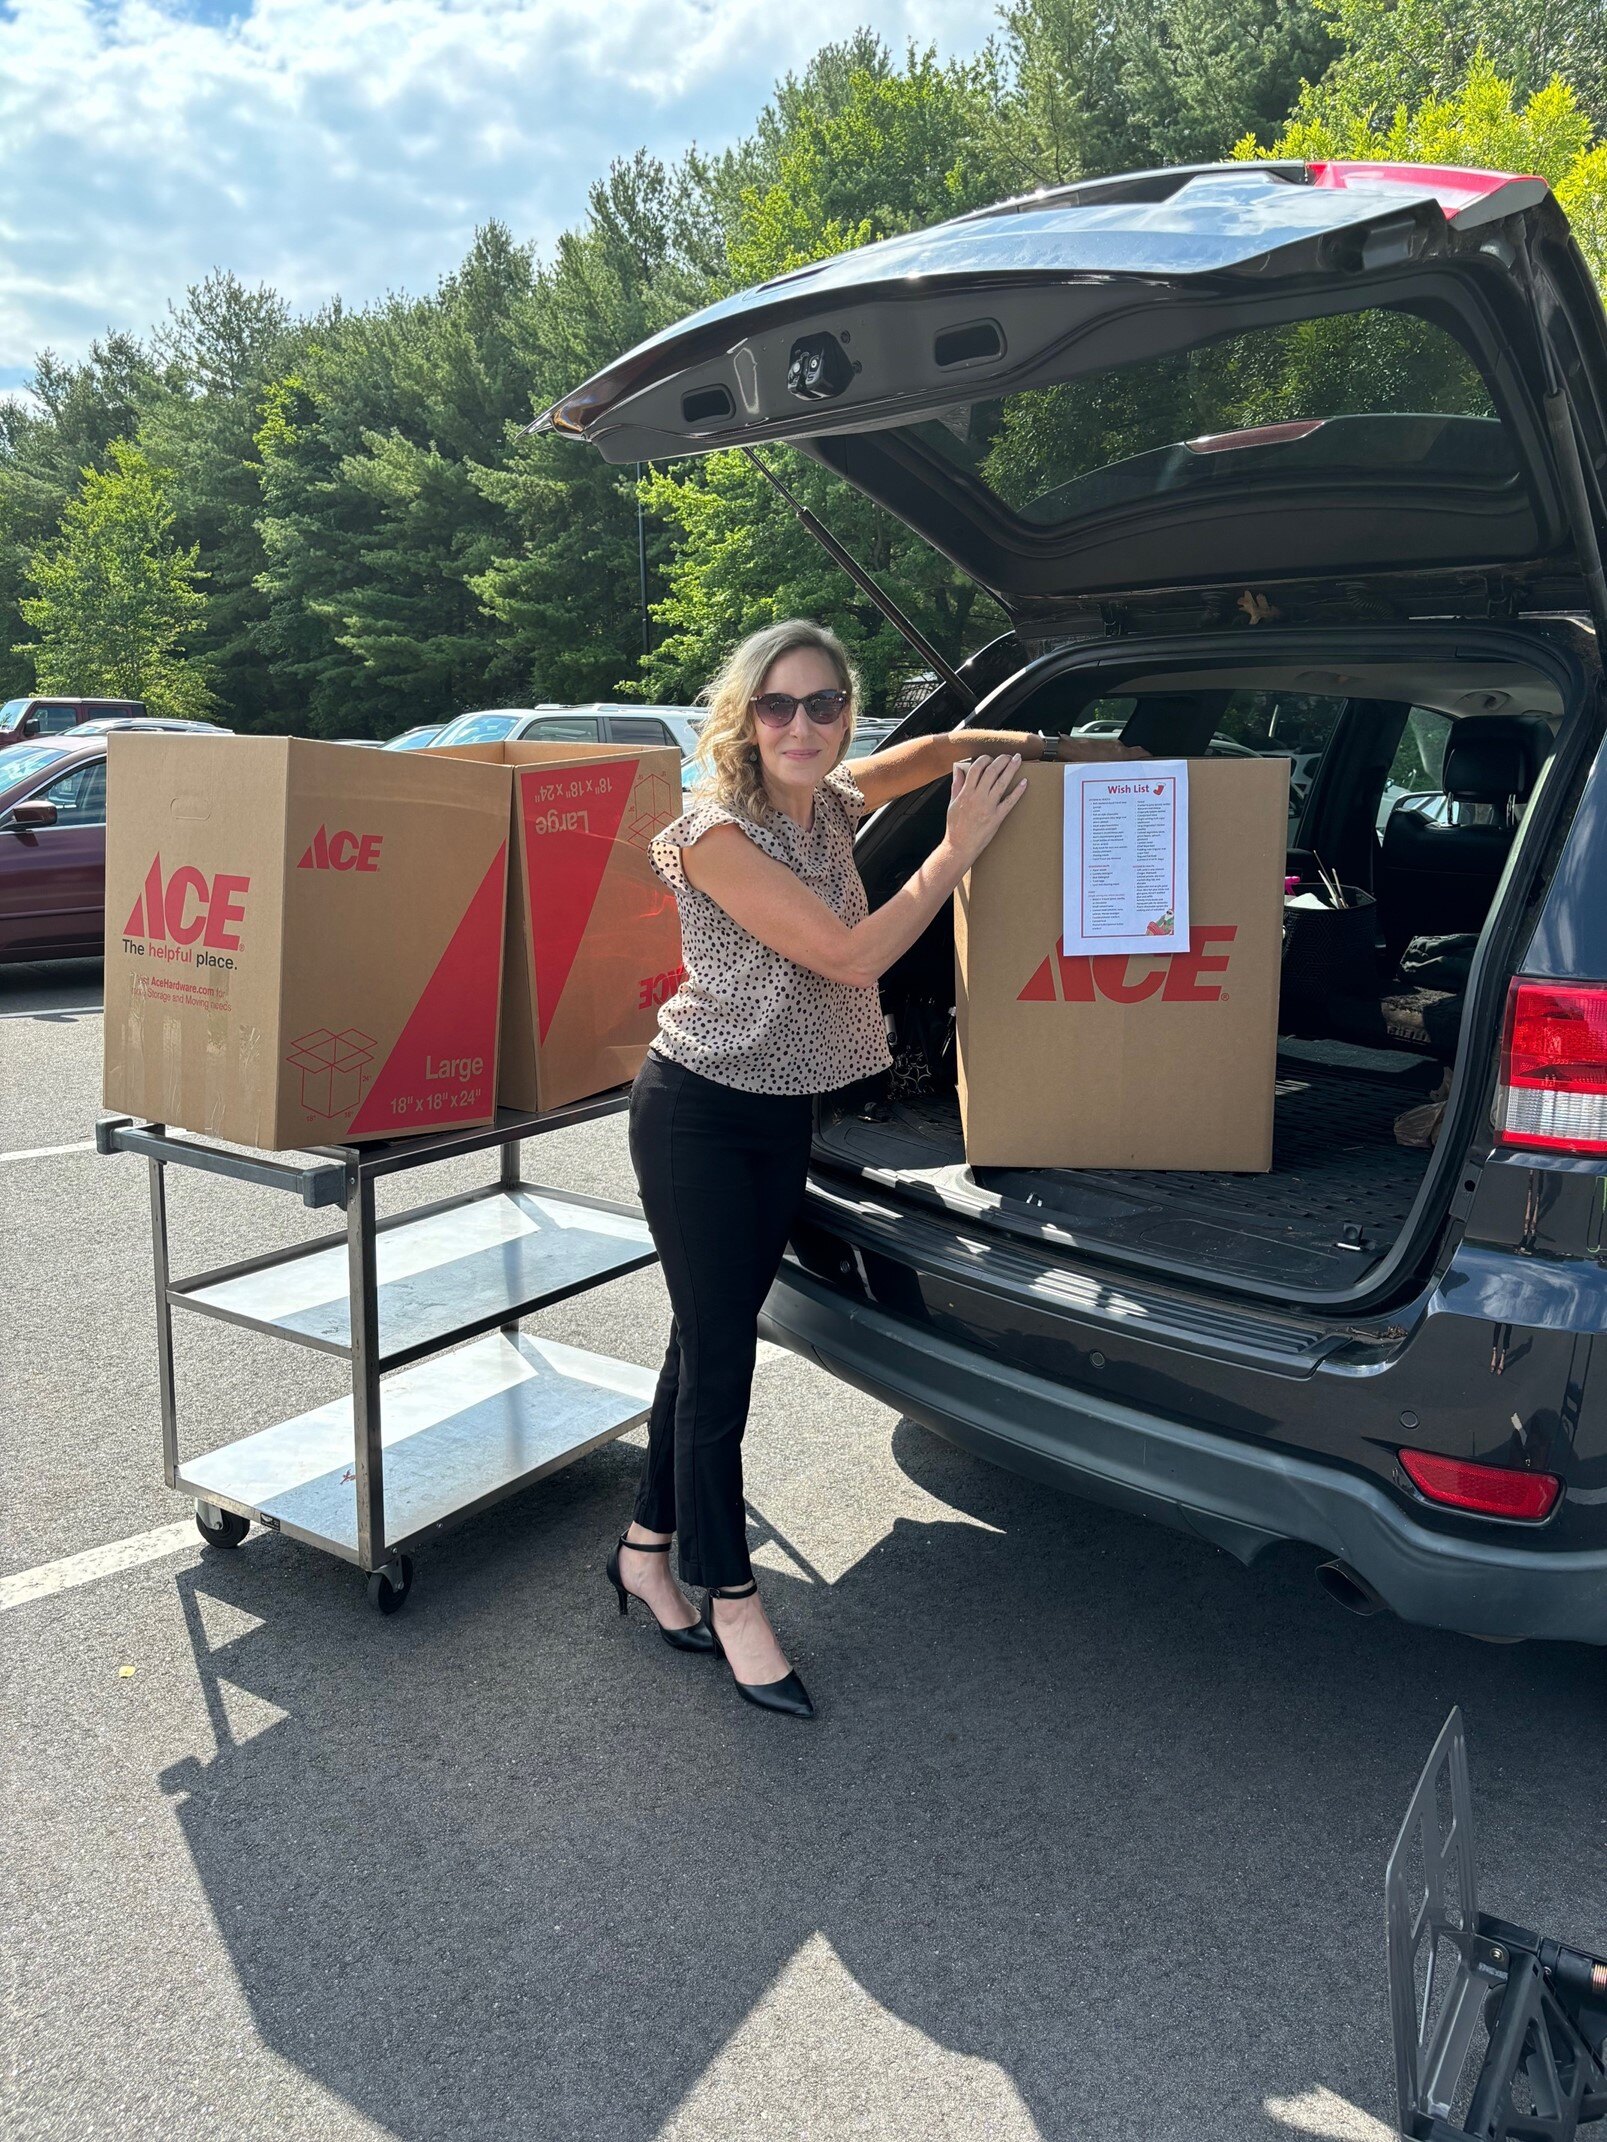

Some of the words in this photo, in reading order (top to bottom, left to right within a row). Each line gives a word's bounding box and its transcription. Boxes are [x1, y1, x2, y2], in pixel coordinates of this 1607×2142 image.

[535, 784, 556, 803] 24"
[556, 783, 563, 796] x
[566, 781, 585, 798] 18"
[586, 779, 593, 792] x
[595, 777, 613, 795] 18"
[1107, 785, 1131, 795] Wish
[1133, 784, 1150, 794] List
[535, 809, 589, 835] Large
[296, 823, 384, 872] ACE
[122, 850, 251, 952] ACE
[122, 938, 145, 956] The
[148, 942, 192, 963] helpful
[196, 951, 238, 971] place.
[151, 976, 215, 997] AceHardware.com
[215, 987, 226, 998] for
[147, 988, 171, 1003] Storage
[172, 993, 184, 1004] and
[185, 995, 209, 1011] Moving
[210, 1001, 232, 1013] needs
[425, 1055, 484, 1082] Large
[390, 1096, 414, 1115] 18"
[415, 1099, 424, 1112] x
[428, 1092, 449, 1110] 18"
[450, 1095, 458, 1108] x
[460, 1088, 481, 1107] 24"
